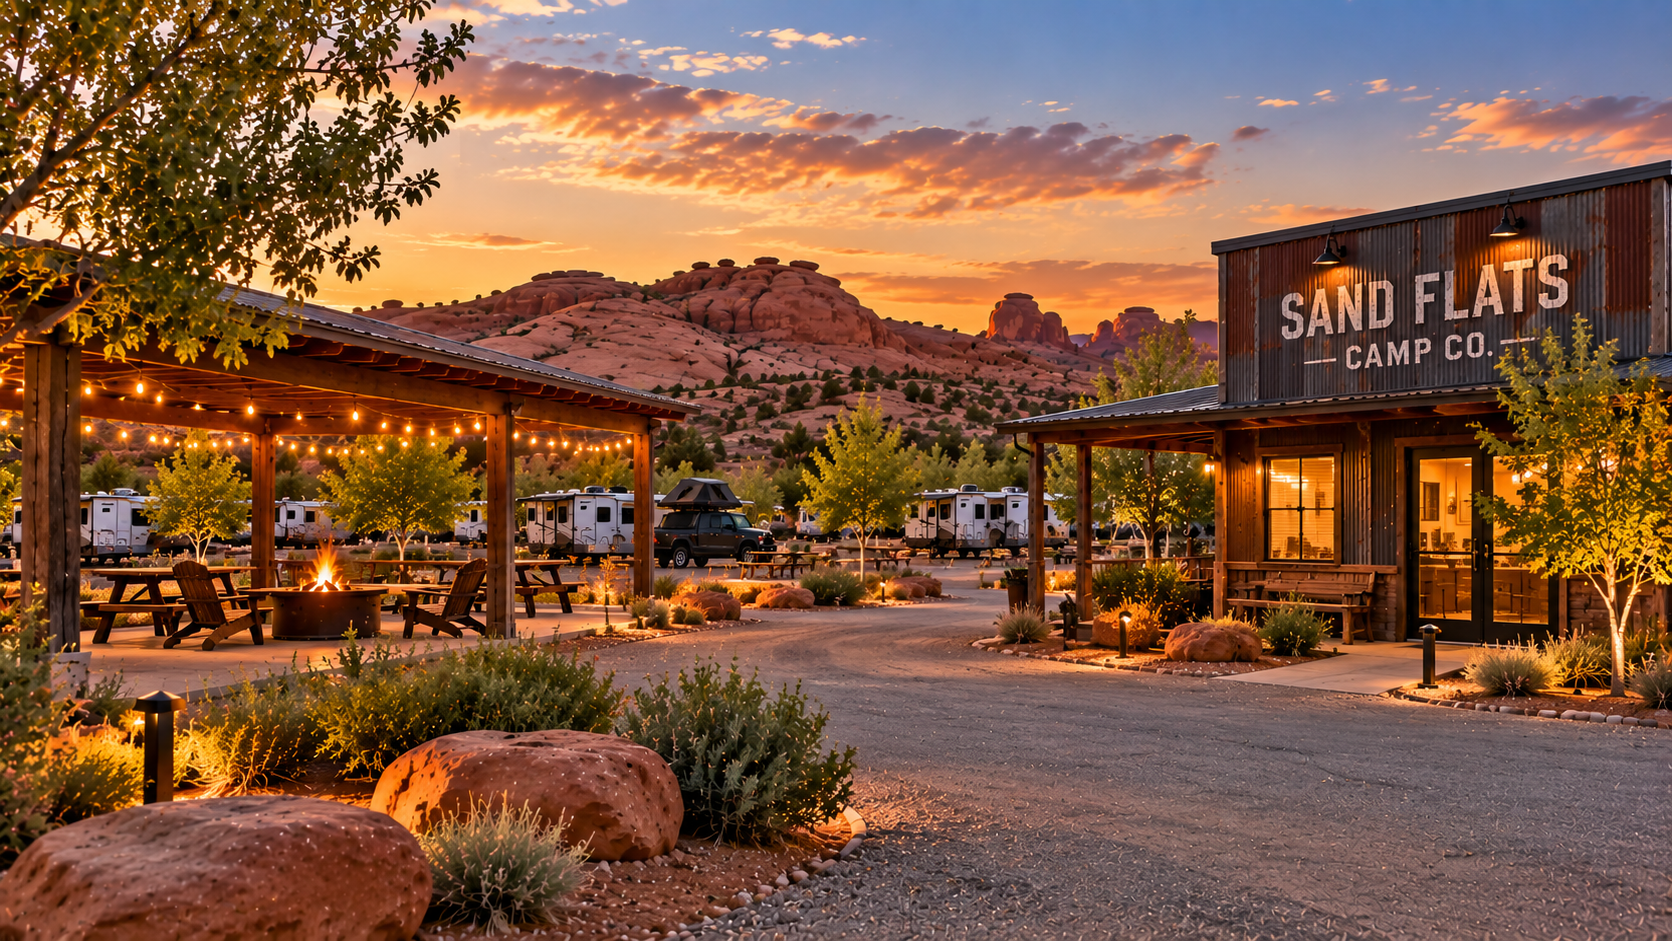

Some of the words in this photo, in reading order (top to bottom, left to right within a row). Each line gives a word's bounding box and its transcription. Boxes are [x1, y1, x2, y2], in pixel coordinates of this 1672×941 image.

[1281, 280, 1395, 341] SAND
[1414, 254, 1569, 325] FLATS
[1345, 338, 1432, 370] CAMP
[1444, 332, 1494, 361] CO.
